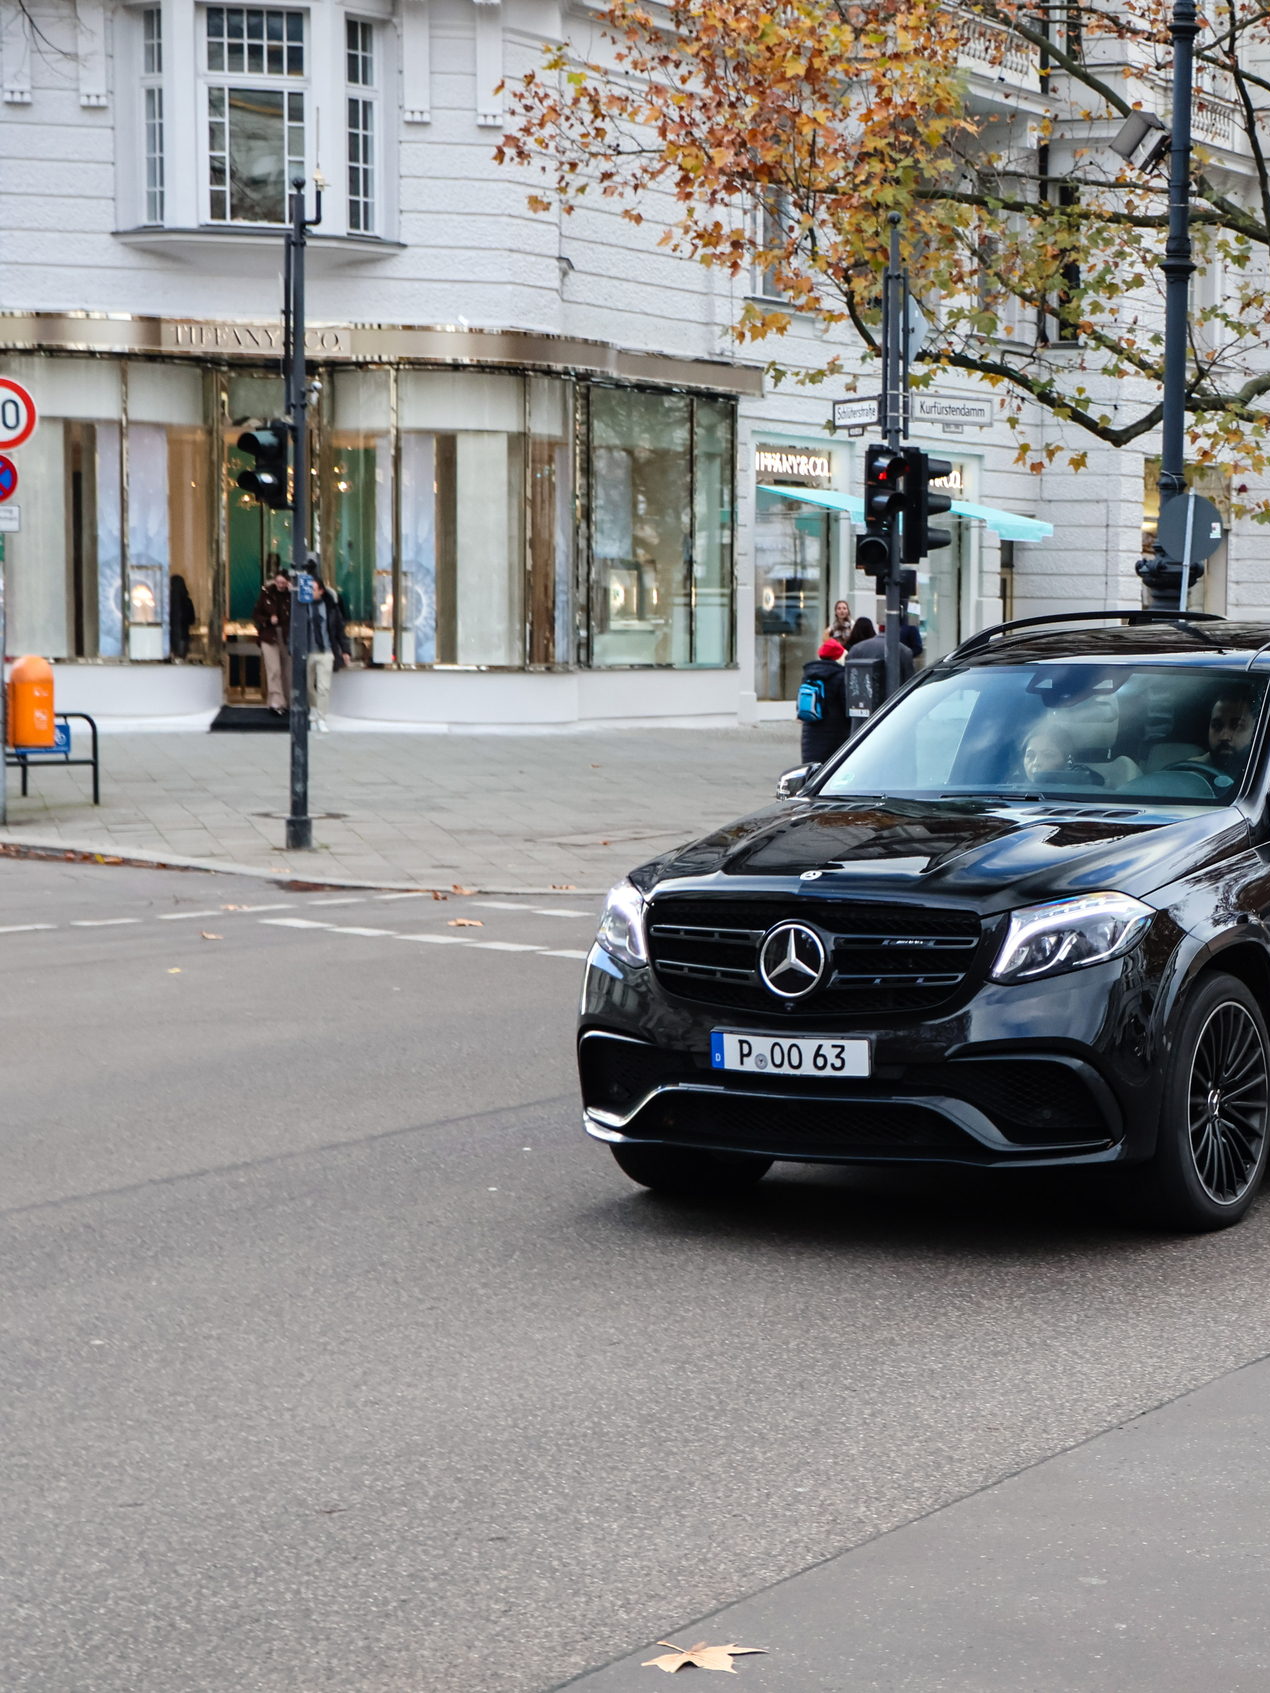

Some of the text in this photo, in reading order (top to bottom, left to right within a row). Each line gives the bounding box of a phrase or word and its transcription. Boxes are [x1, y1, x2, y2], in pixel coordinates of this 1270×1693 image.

[171, 324, 280, 348] TIFFANY
[1, 398, 20, 431] 0
[919, 401, 986, 418] Kurfürstendamm
[755, 451, 832, 478] IFFANY&CO.
[715, 1053, 722, 1062] D
[737, 1039, 752, 1066] P
[812, 1043, 846, 1071] 63
